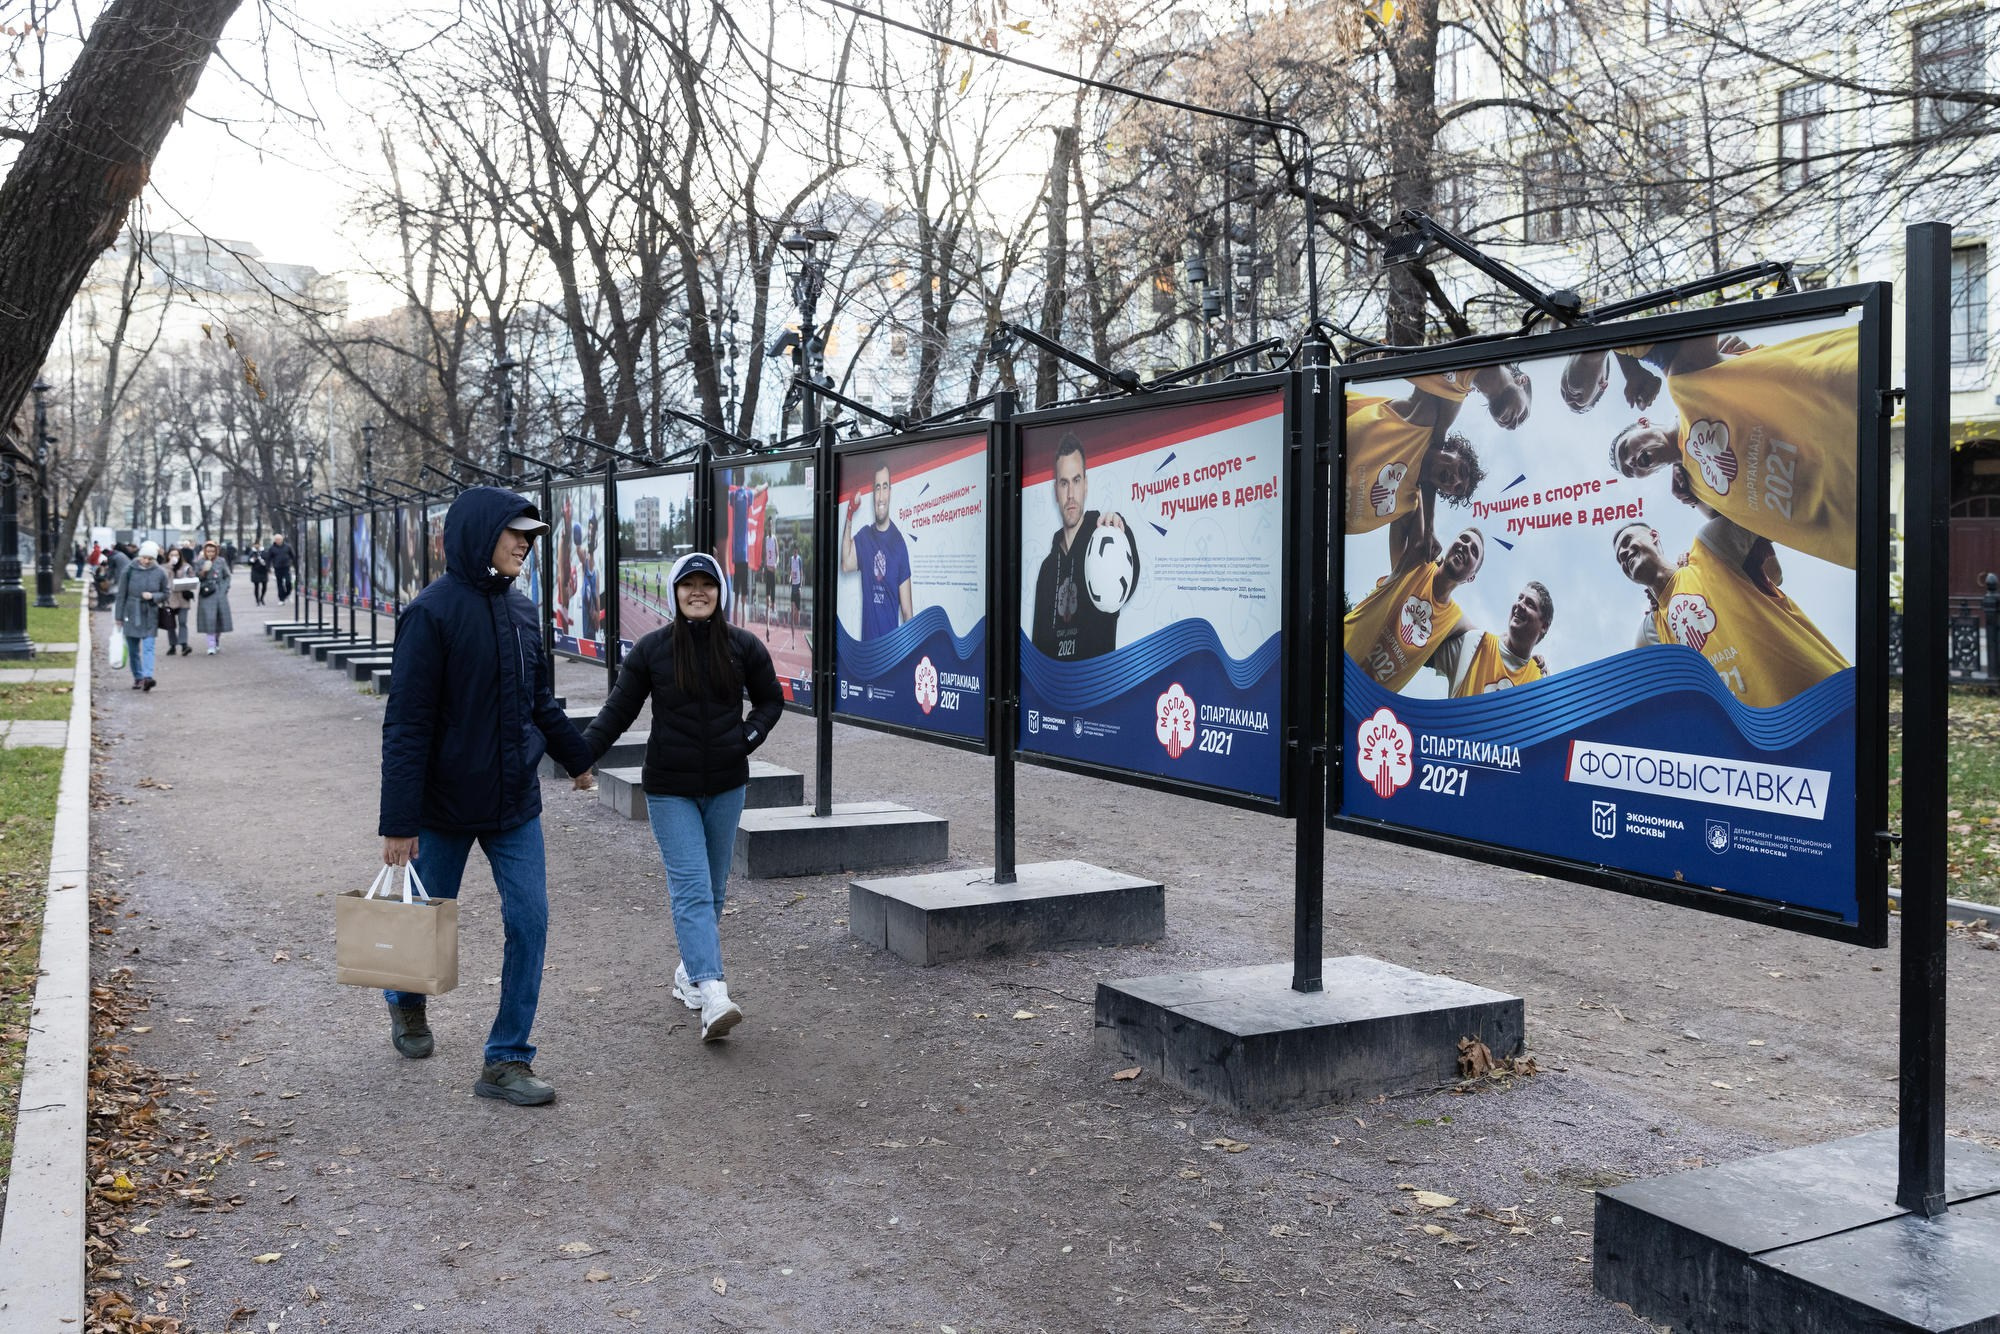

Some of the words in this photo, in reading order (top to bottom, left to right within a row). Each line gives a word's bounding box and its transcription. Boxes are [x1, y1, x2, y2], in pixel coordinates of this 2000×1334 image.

[1131, 474, 1180, 503] Лучшие
[1183, 472, 1191, 486] в
[1193, 456, 1242, 482] спорте
[1763, 438, 1798, 520] 2021
[931, 499, 982, 523] победителем!
[1161, 492, 1218, 520] лучшие
[1222, 490, 1231, 506] в
[1234, 475, 1278, 508] деле!
[1472, 494, 1529, 520] Лучшие
[1533, 492, 1542, 505] в
[1545, 479, 1601, 502] спорте
[1507, 510, 1573, 536] лучшие
[1578, 509, 1588, 524] в
[1592, 497, 1644, 525] деле!
[1058, 639, 1076, 657] 2021
[940, 671, 980, 691] СПАРТАКИАДА
[940, 690, 960, 711] 2021
[1160, 697, 1191, 732] МОСПРОМ
[1200, 704, 1269, 732] СПАРТАКИАДА
[1199, 728, 1233, 756] 2021
[1363, 724, 1407, 767] МОСПРОМ
[1420, 734, 1521, 769] СПАРТАКИАДА
[1419, 763, 1469, 797] 2021
[1579, 750, 1817, 809] ФОТОВЫСТАВКА
[1625, 824, 1666, 840] МОСКВЫ
[1626, 812, 1685, 831] ЭКОНОМИКА
[1733, 828, 1773, 840] ДЕПАРТАМЕНТ
[1774, 834, 1832, 850] ИНВЕСТИЦИОННОЙ
[1733, 843, 1759, 853] ГОРОДА
[1760, 848, 1788, 858] МОСКВЫ
[1739, 836, 1789, 850] ПРОМЫШЛЕННОЙ
[1789, 844, 1824, 856] ПОЛИТИКИ
